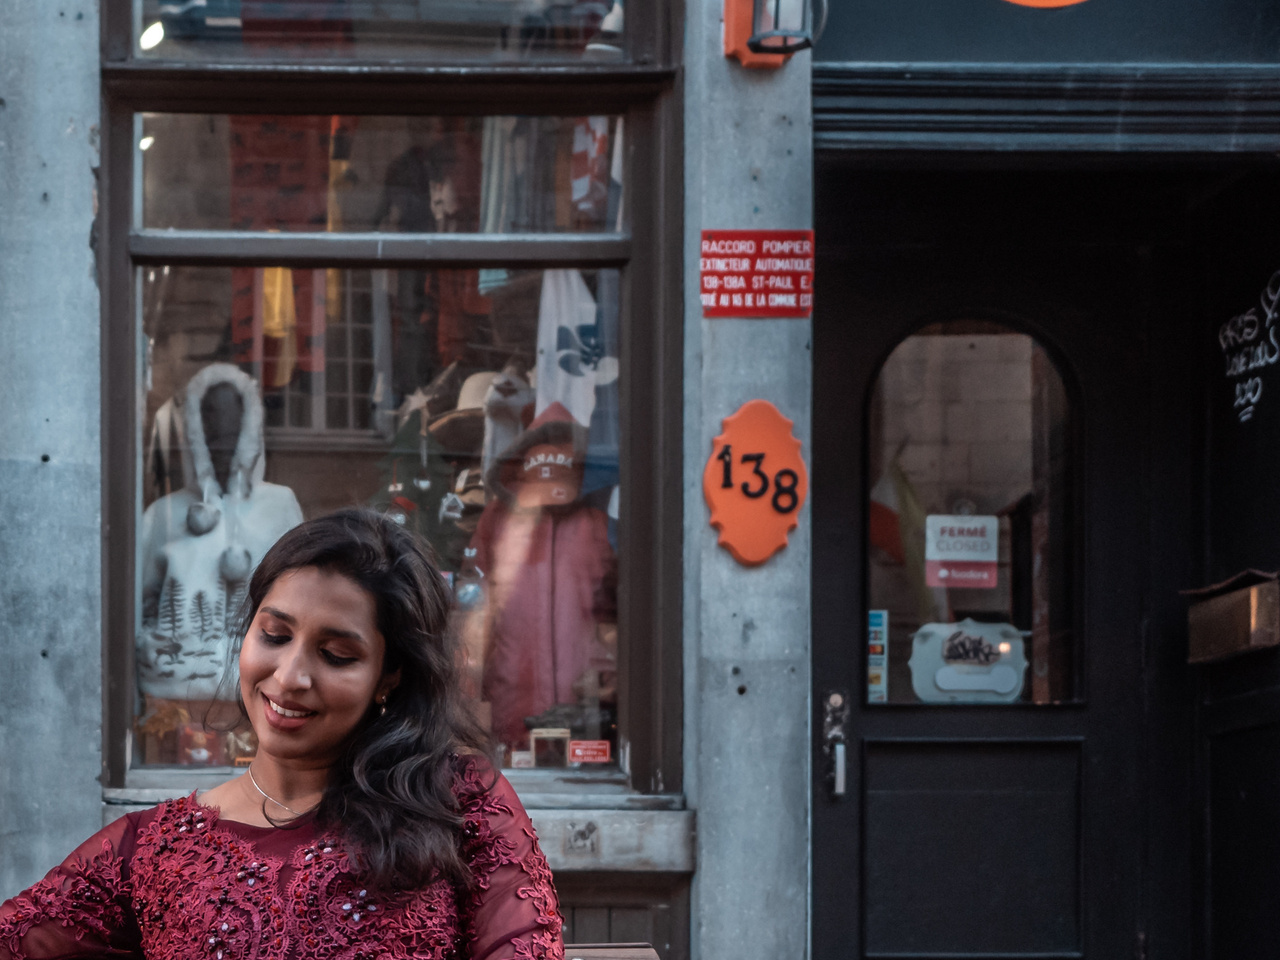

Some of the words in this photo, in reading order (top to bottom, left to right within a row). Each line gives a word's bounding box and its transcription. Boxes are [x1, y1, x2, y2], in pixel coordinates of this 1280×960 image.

[701, 240, 756, 254] RACCORD
[763, 240, 812, 254] POMPIER
[700, 258, 751, 271] EXTINCTEUR
[755, 258, 813, 271] AUTOMATIQUE
[752, 276, 794, 289] ST-PAUL
[745, 293, 754, 306] DE
[756, 293, 766, 306] LA
[523, 453, 573, 471] CANADA
[717, 444, 799, 515] 138
[939, 524, 987, 538] FERMÉ
[936, 540, 991, 552] CLOSED
